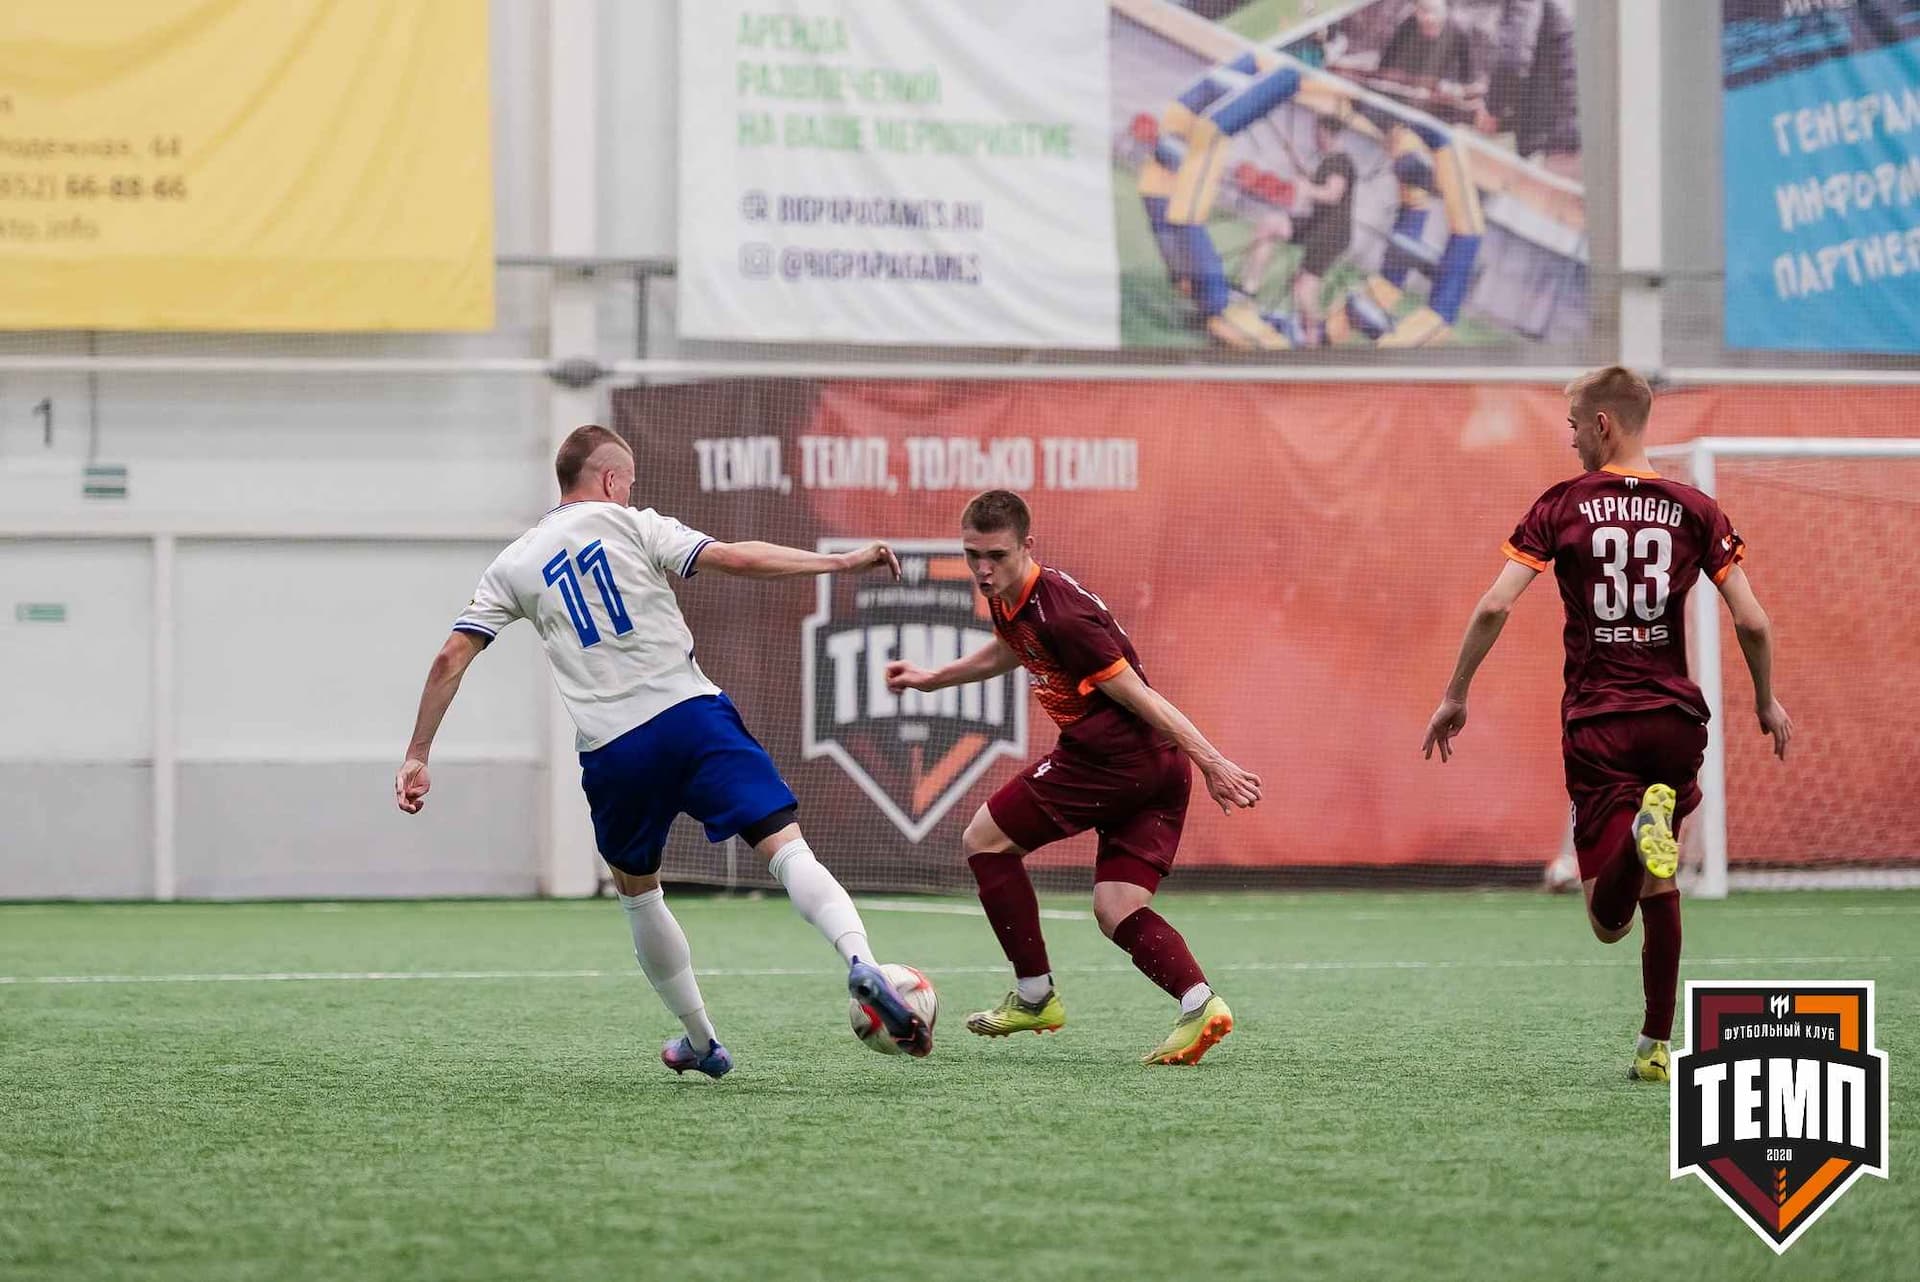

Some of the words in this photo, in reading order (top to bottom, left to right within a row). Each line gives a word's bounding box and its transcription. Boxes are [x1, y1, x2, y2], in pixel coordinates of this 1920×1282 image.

[33, 398, 52, 446] 1
[694, 436, 791, 495] ТЕМП,
[799, 436, 897, 496] ТЕМП,
[905, 437, 1034, 490] ТОЛЬКО
[1042, 436, 1138, 490] ТЕМП!
[1579, 496, 1683, 528] ЧЕРКАСОВ
[541, 538, 634, 648] 11
[1591, 526, 1672, 622] 33
[1594, 625, 1669, 644] SEUS
[826, 623, 1005, 725] ТЕМП
